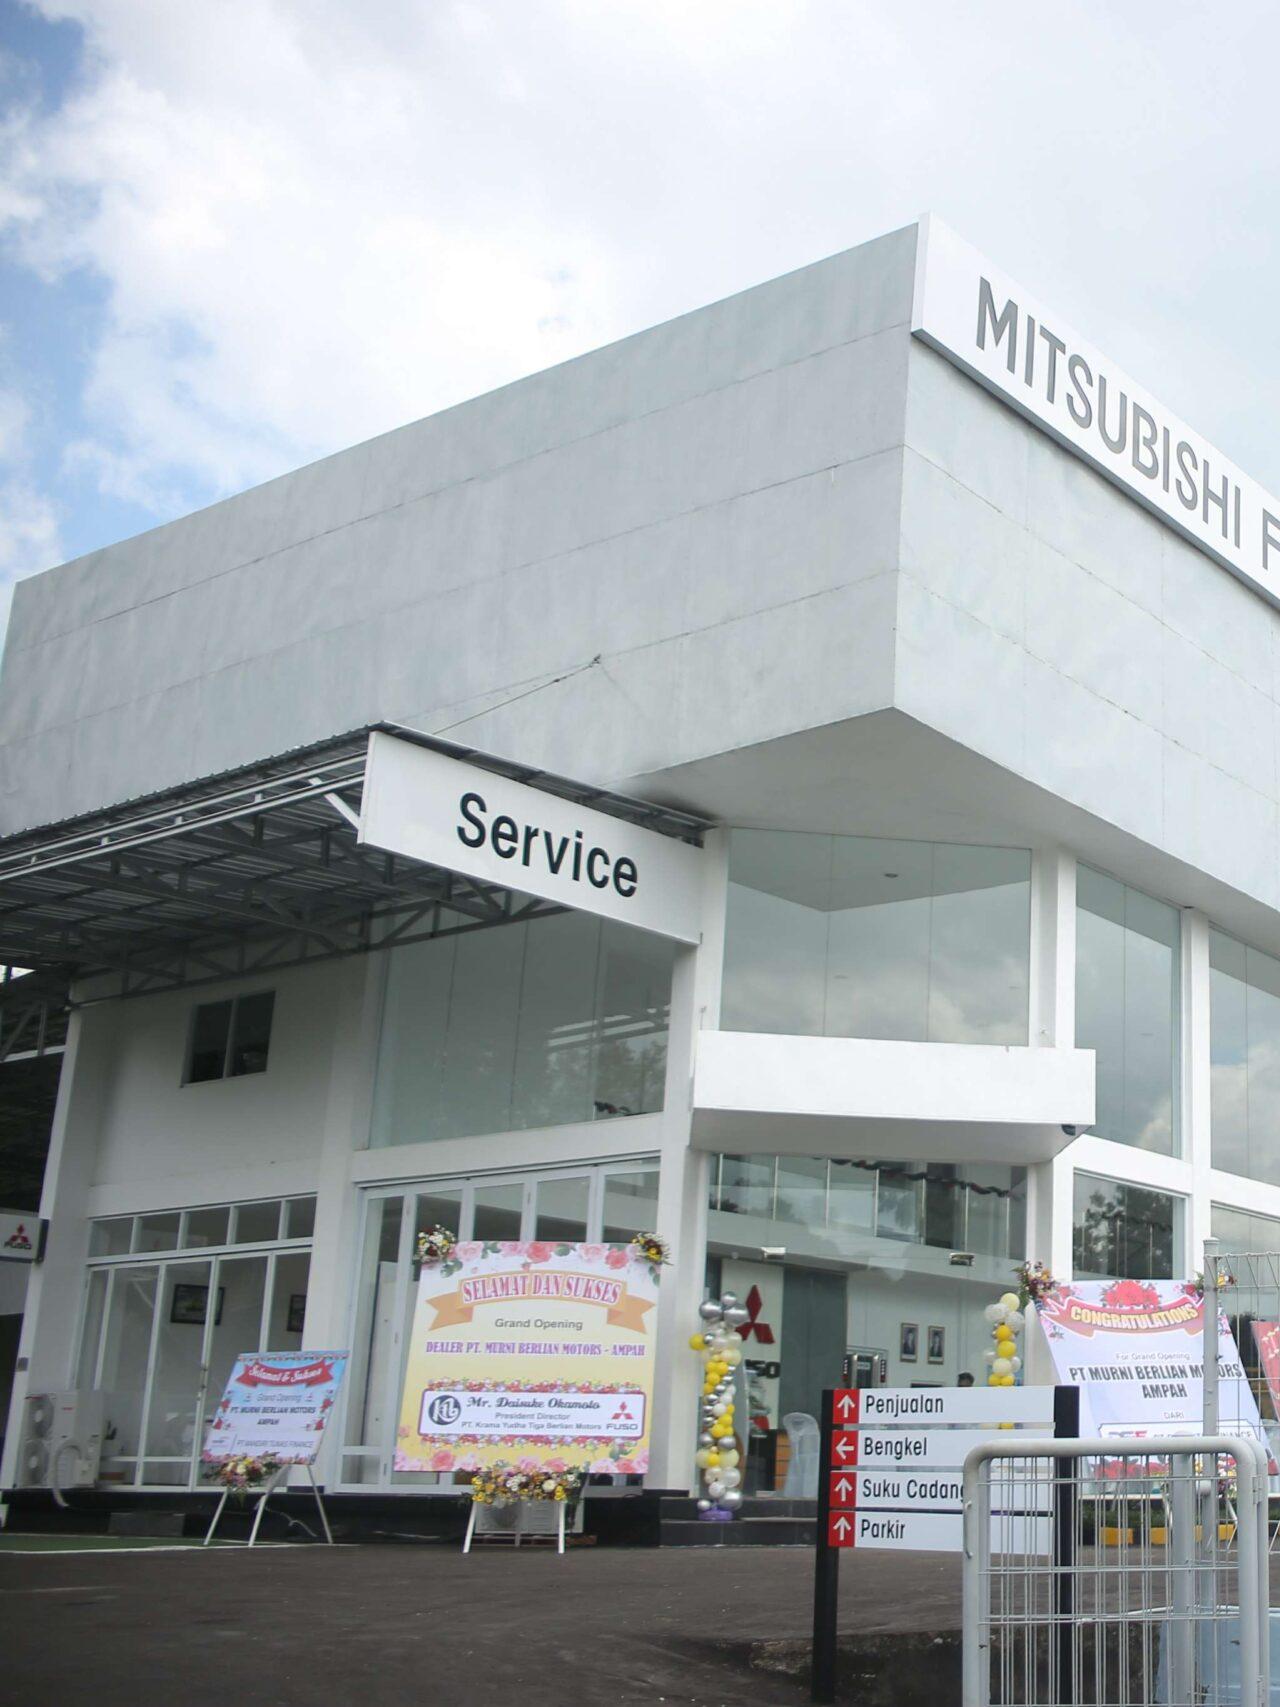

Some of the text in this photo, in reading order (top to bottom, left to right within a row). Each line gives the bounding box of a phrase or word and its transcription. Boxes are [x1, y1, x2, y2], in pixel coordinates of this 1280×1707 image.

[975, 276, 1242, 549] MITSUBISHI
[456, 792, 638, 898] Service
[462, 1274, 622, 1305] SELAMAT DAN SUKSES
[1070, 1303, 1199, 1330] CONGRATULATIONS
[494, 1318, 584, 1332] Grand Opening
[425, 1341, 464, 1354] DEALER
[466, 1342, 482, 1354] PT.
[485, 1342, 516, 1355] MURNI
[518, 1343, 560, 1355] BERLIAN
[562, 1344, 602, 1356] MOTORS
[610, 1344, 646, 1357] AMPAH
[1132, 1352, 1156, 1360] Grand
[1157, 1352, 1191, 1362] Opening
[1068, 1366, 1085, 1381] PT
[1088, 1366, 1134, 1380] MURNI
[1135, 1364, 1188, 1380] BERLIAN
[1142, 1383, 1188, 1399] AMPAH
[465, 1396, 601, 1410] Mr. Daisuke Okamoto
[865, 1394, 944, 1417] Penjualan
[494, 1412, 570, 1420] President Director
[1164, 1411, 1185, 1420] DARI
[475, 1421, 500, 1429] Krama
[528, 1422, 545, 1431] Tiga
[546, 1422, 574, 1430] Berlian
[575, 1422, 602, 1431] Motors
[605, 1422, 639, 1431] FUSO
[863, 1436, 928, 1460] Bengkel
[862, 1478, 900, 1498] Suku
[860, 1518, 906, 1540] Parkir
